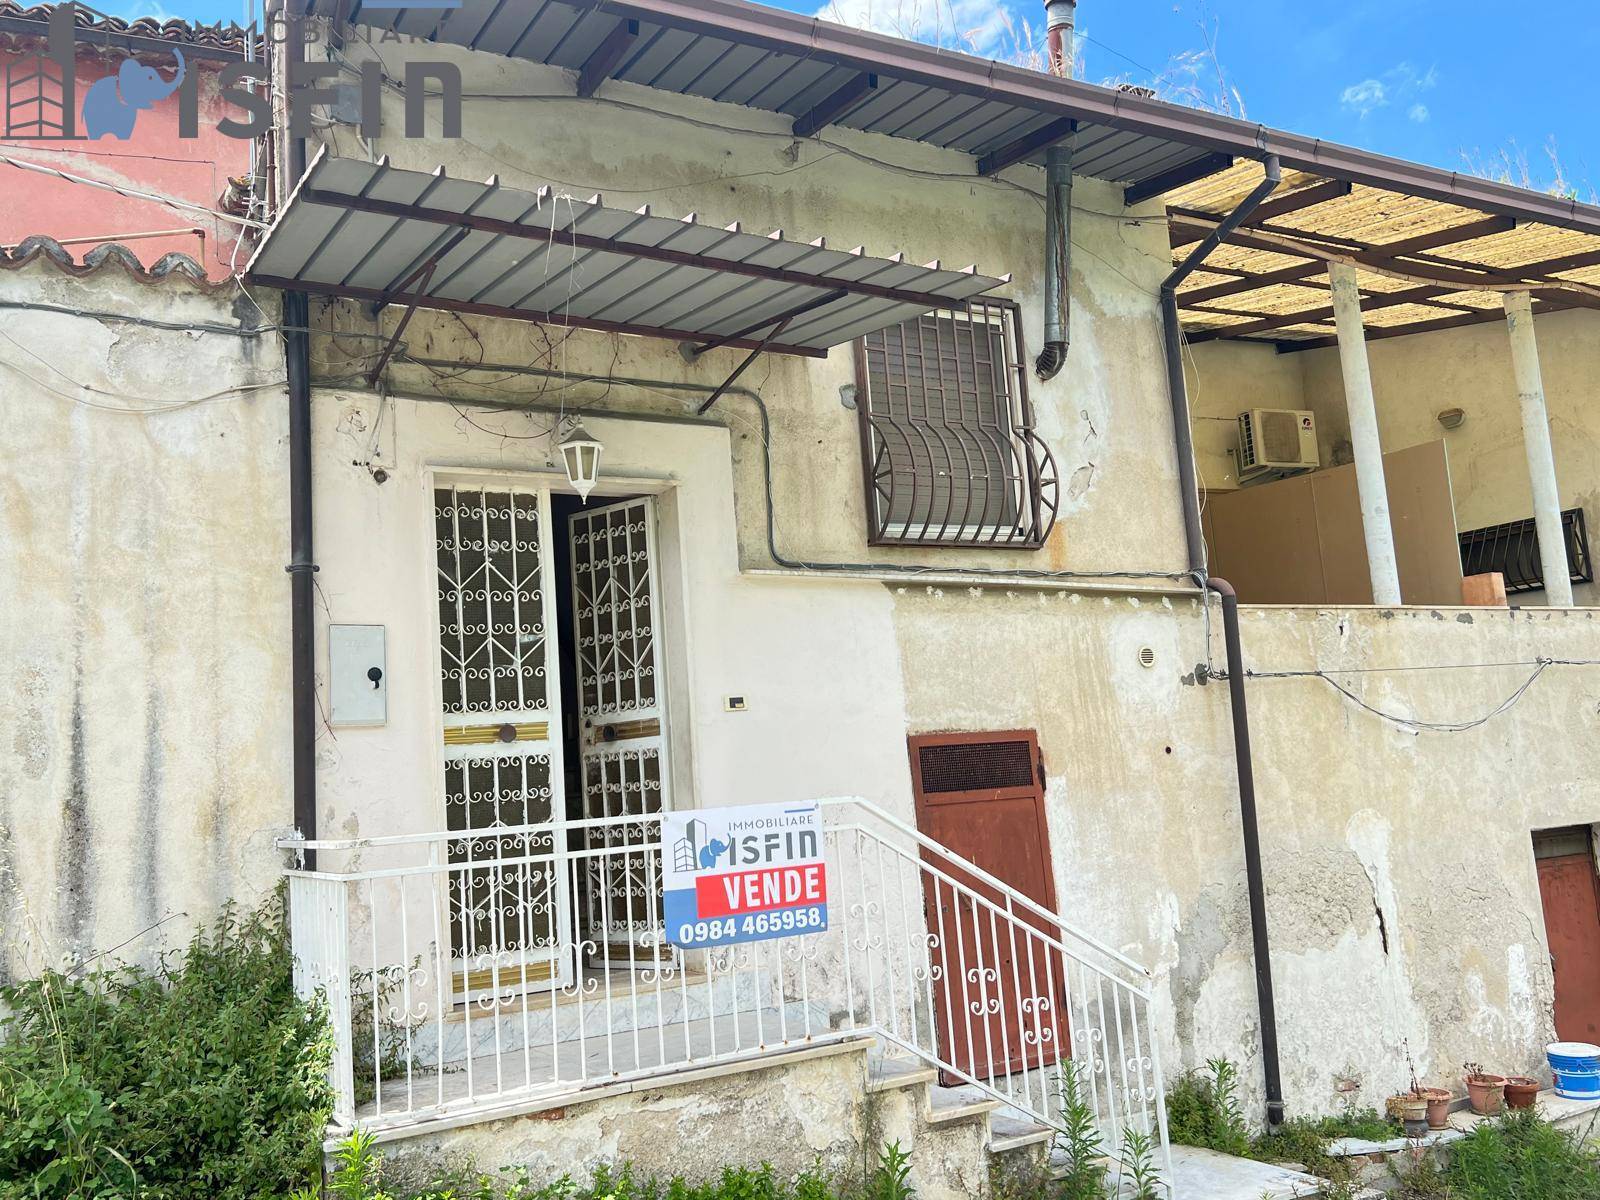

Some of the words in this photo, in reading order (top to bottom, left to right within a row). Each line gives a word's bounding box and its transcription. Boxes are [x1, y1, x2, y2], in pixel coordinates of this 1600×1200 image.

[728, 815, 814, 831] IMMOBILIARE
[729, 830, 818, 866] ISFIN
[723, 867, 820, 910] VENDE
[679, 918, 737, 944] 0984
